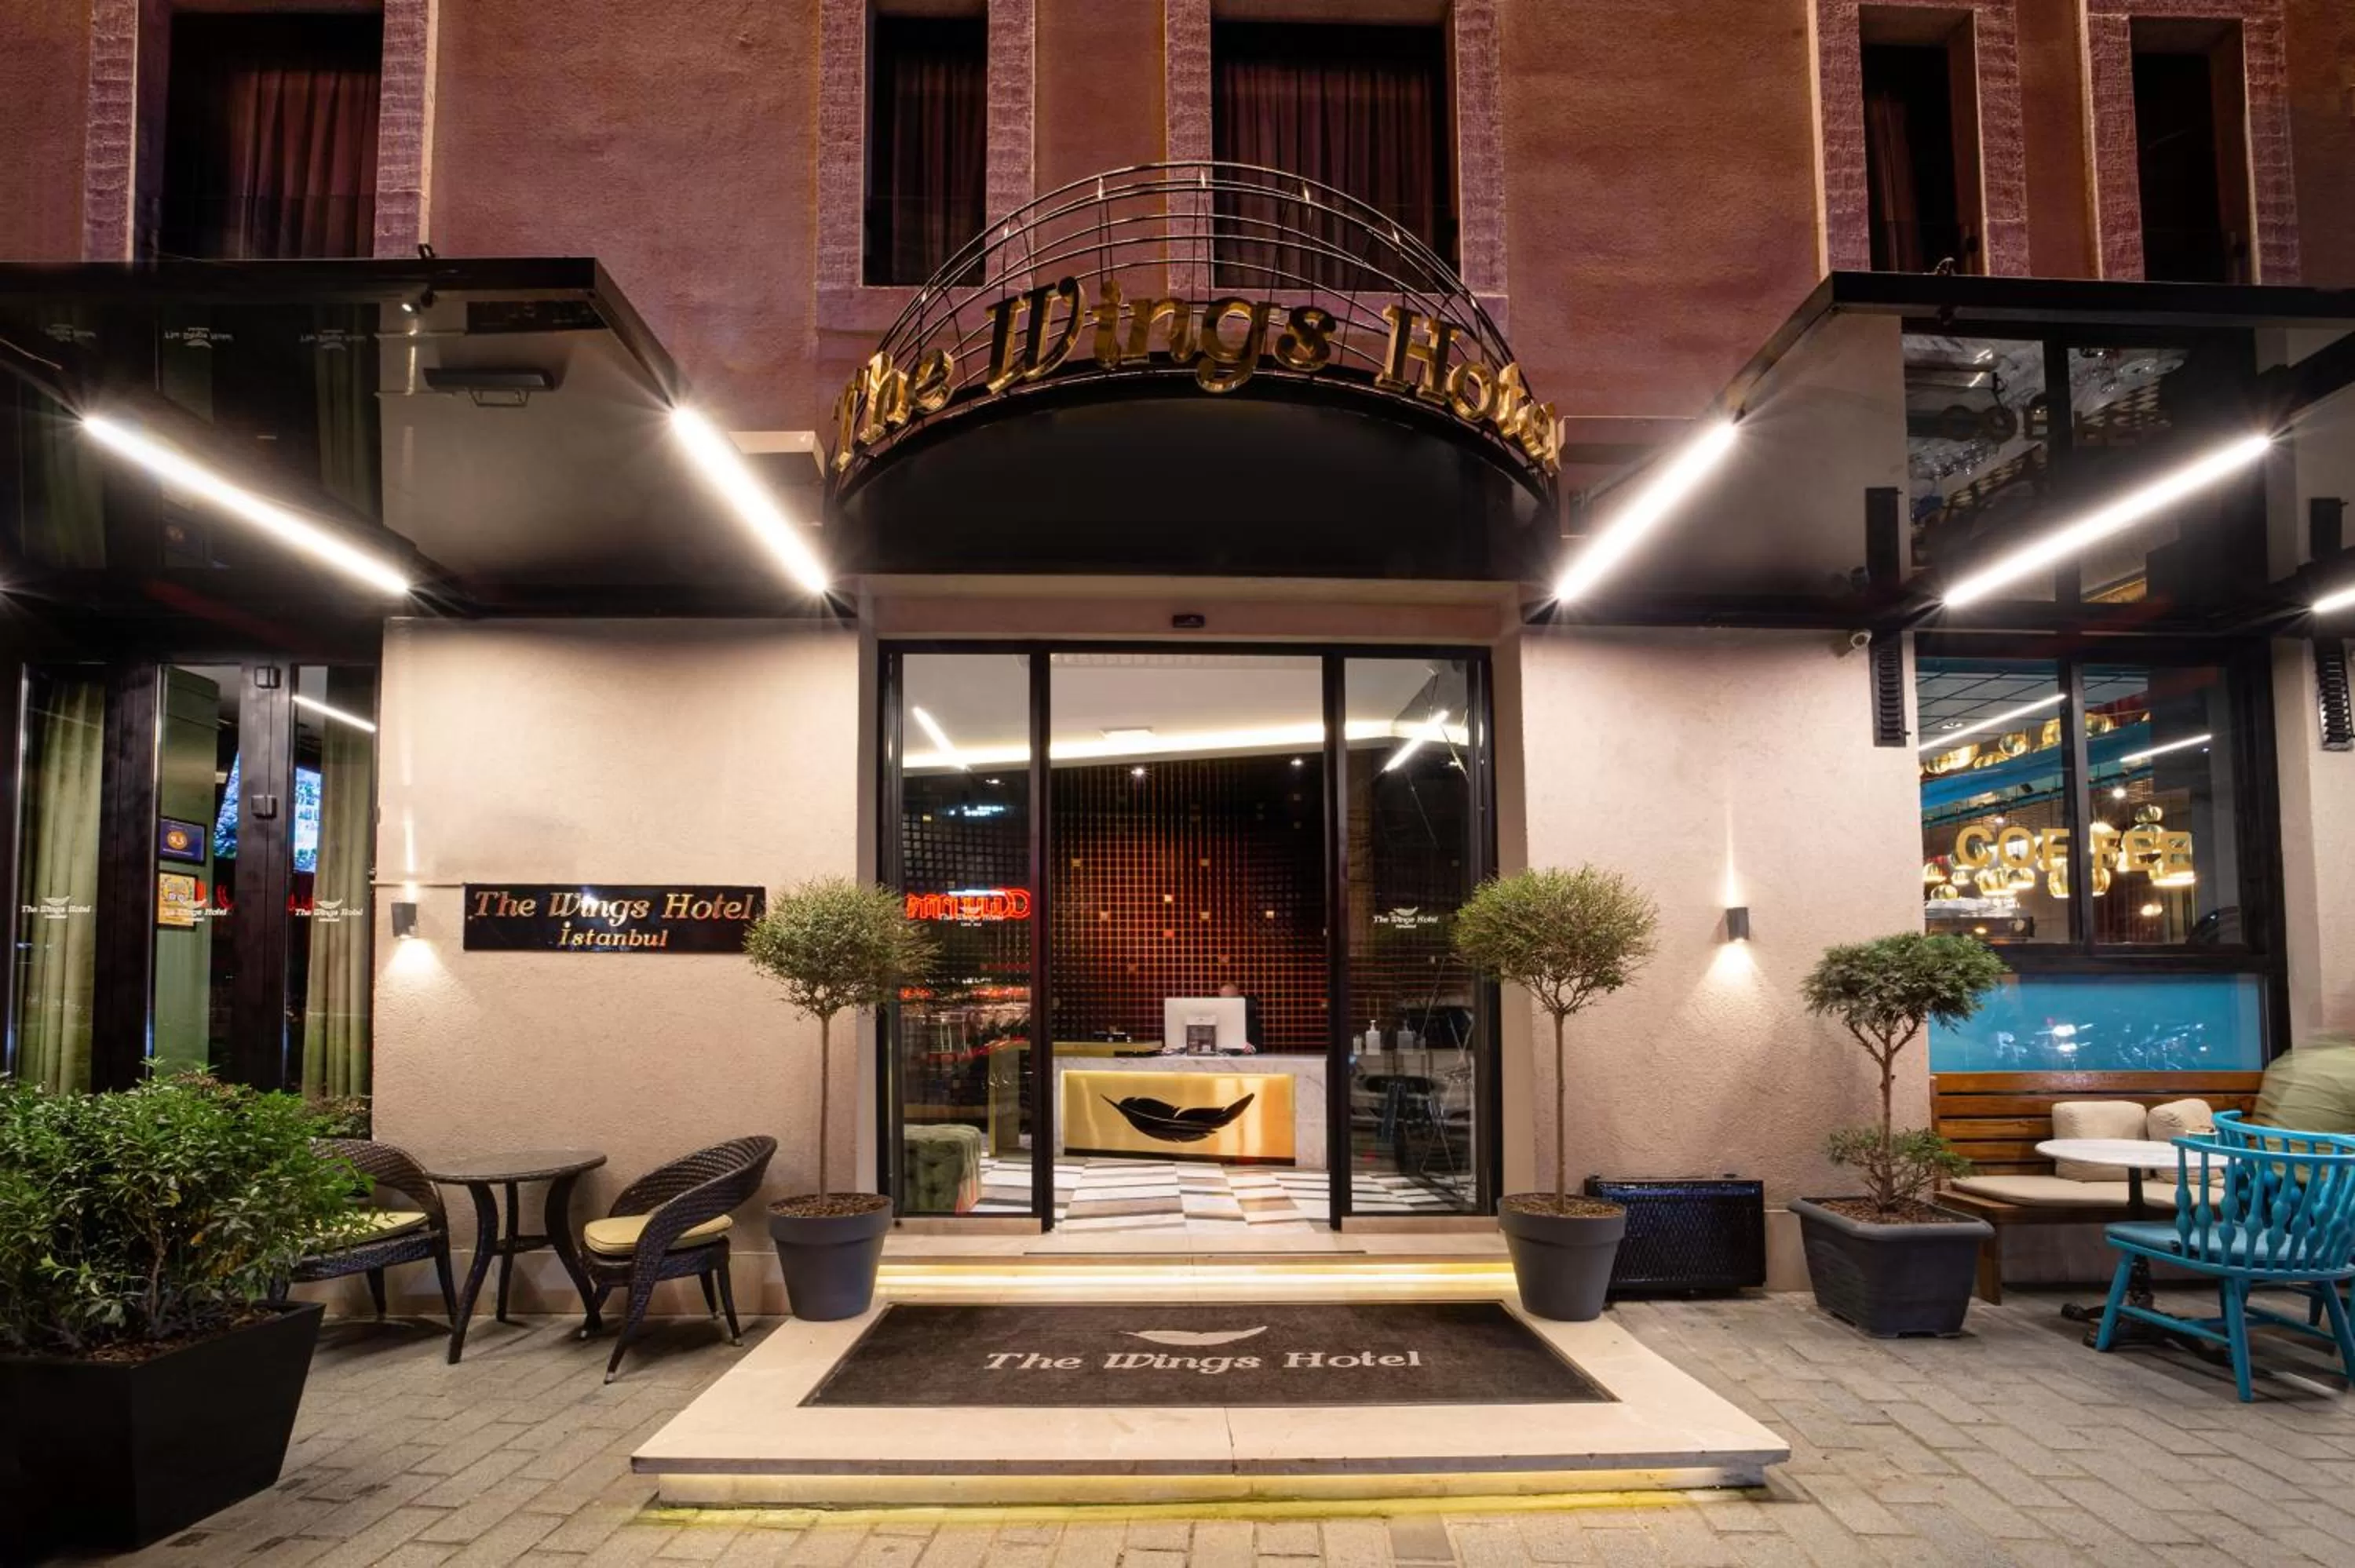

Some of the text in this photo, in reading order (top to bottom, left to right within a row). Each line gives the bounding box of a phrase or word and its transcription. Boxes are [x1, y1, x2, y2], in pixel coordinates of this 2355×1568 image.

[832, 275, 1561, 475] The Wings Hotel
[1955, 825, 2193, 871] COFFEE
[474, 891, 755, 927] The Wings Hotel
[984, 1351, 1422, 1374] The Wings Hotel
